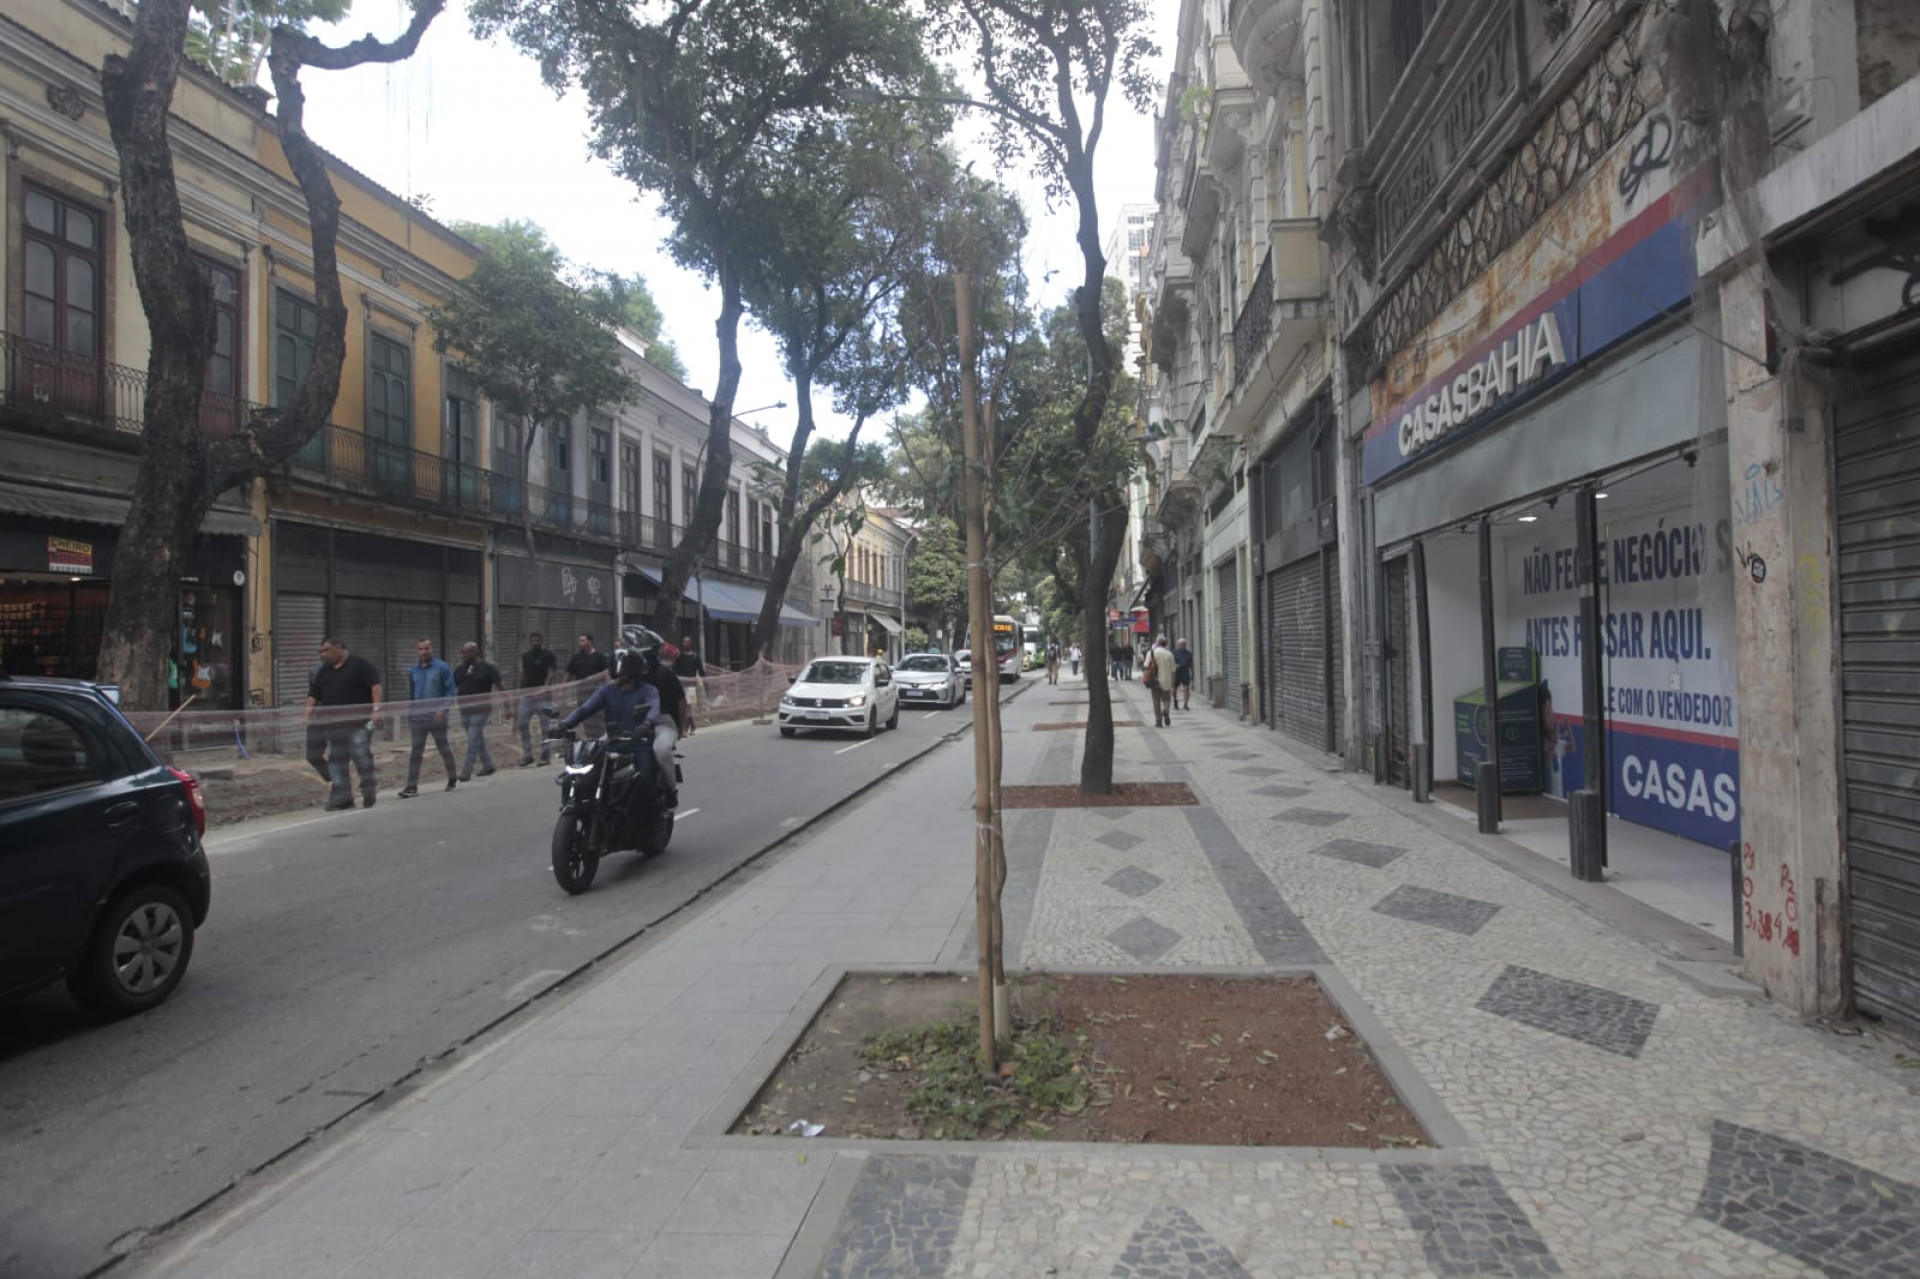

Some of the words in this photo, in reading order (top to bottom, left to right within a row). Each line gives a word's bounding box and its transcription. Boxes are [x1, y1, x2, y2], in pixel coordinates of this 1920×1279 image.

[1523, 547, 1549, 595] NÃO
[1525, 616, 1569, 657] ANTES
[1650, 608, 1711, 664] AQUI.
[1618, 688, 1643, 716] COM
[1647, 689, 1654, 718] O
[1658, 690, 1733, 727] VENDEDOR
[1622, 755, 1736, 822] CASAS
